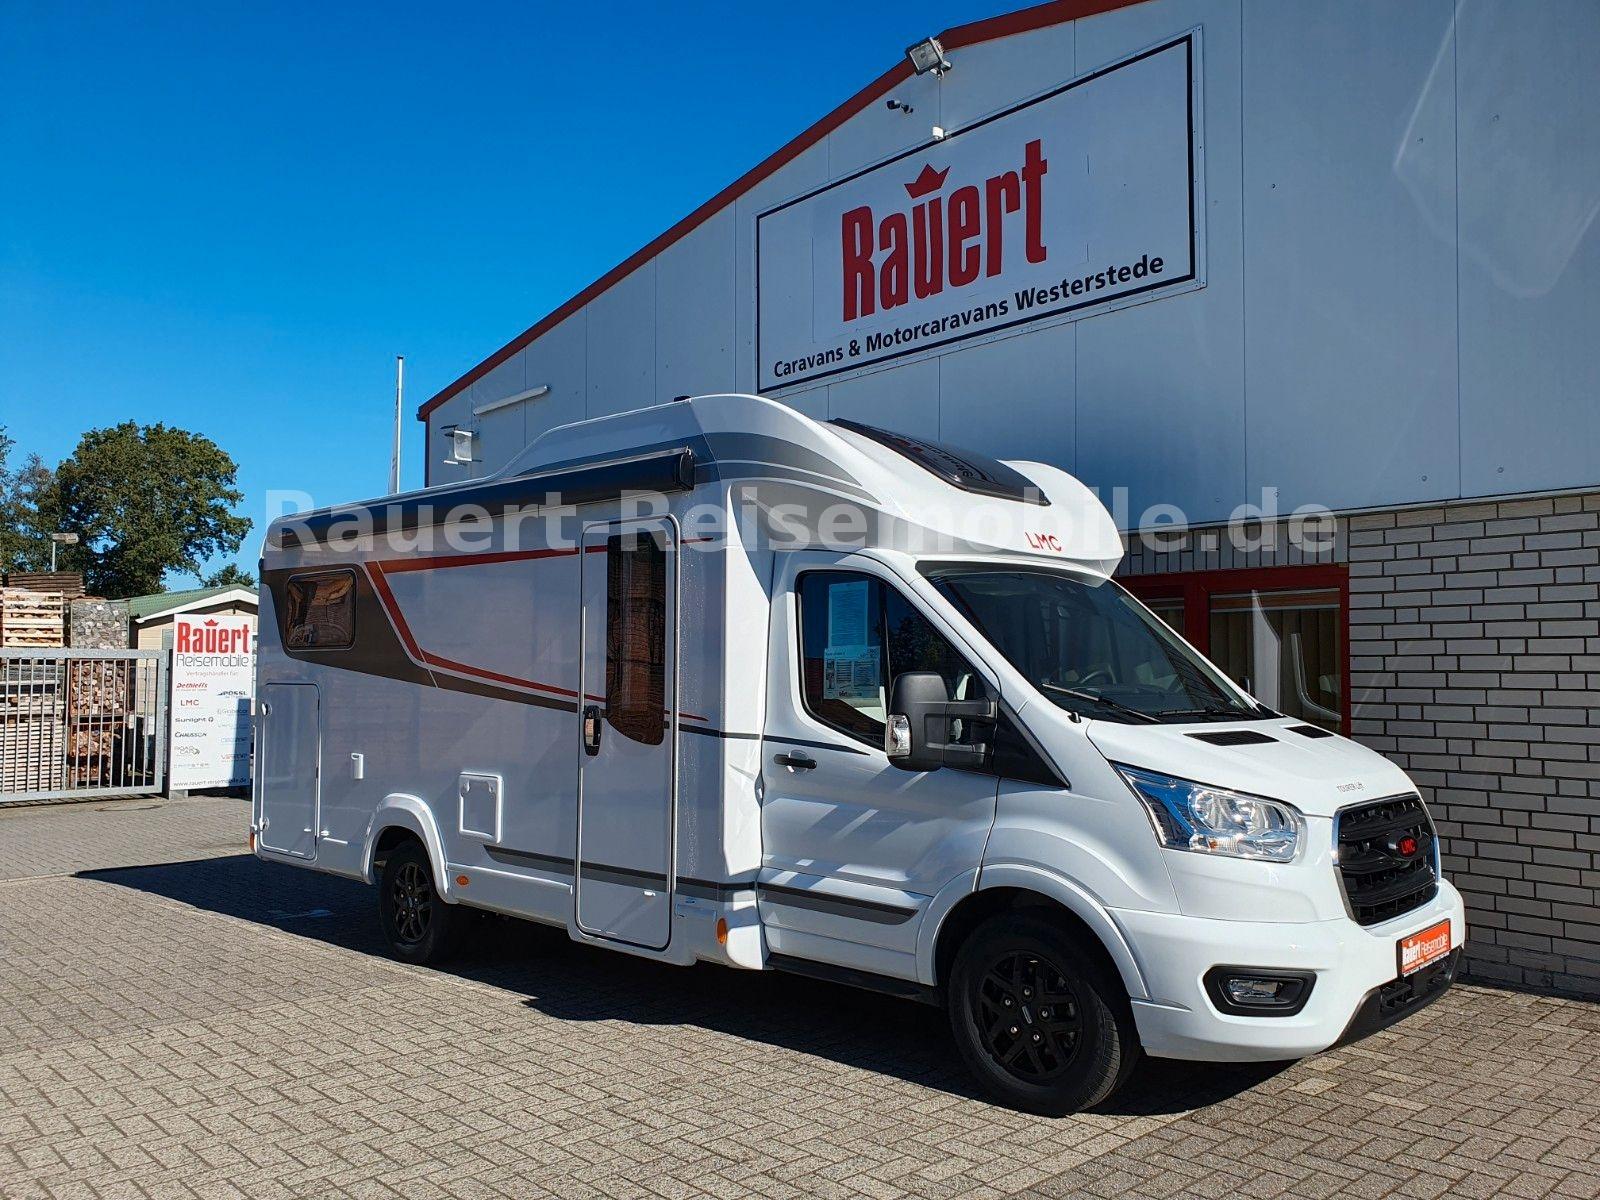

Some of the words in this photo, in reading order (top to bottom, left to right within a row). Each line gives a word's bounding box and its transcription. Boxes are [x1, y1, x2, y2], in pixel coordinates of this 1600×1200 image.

[842, 138, 1047, 322] Rauert
[774, 346, 844, 379] Caravans
[848, 339, 861, 357] &
[866, 298, 1009, 353] Motorcaravans
[1014, 254, 1164, 311] Westerstede
[1024, 531, 1062, 552] LMC
[177, 622, 249, 654] Rauert
[176, 653, 249, 667] Reisemobile
